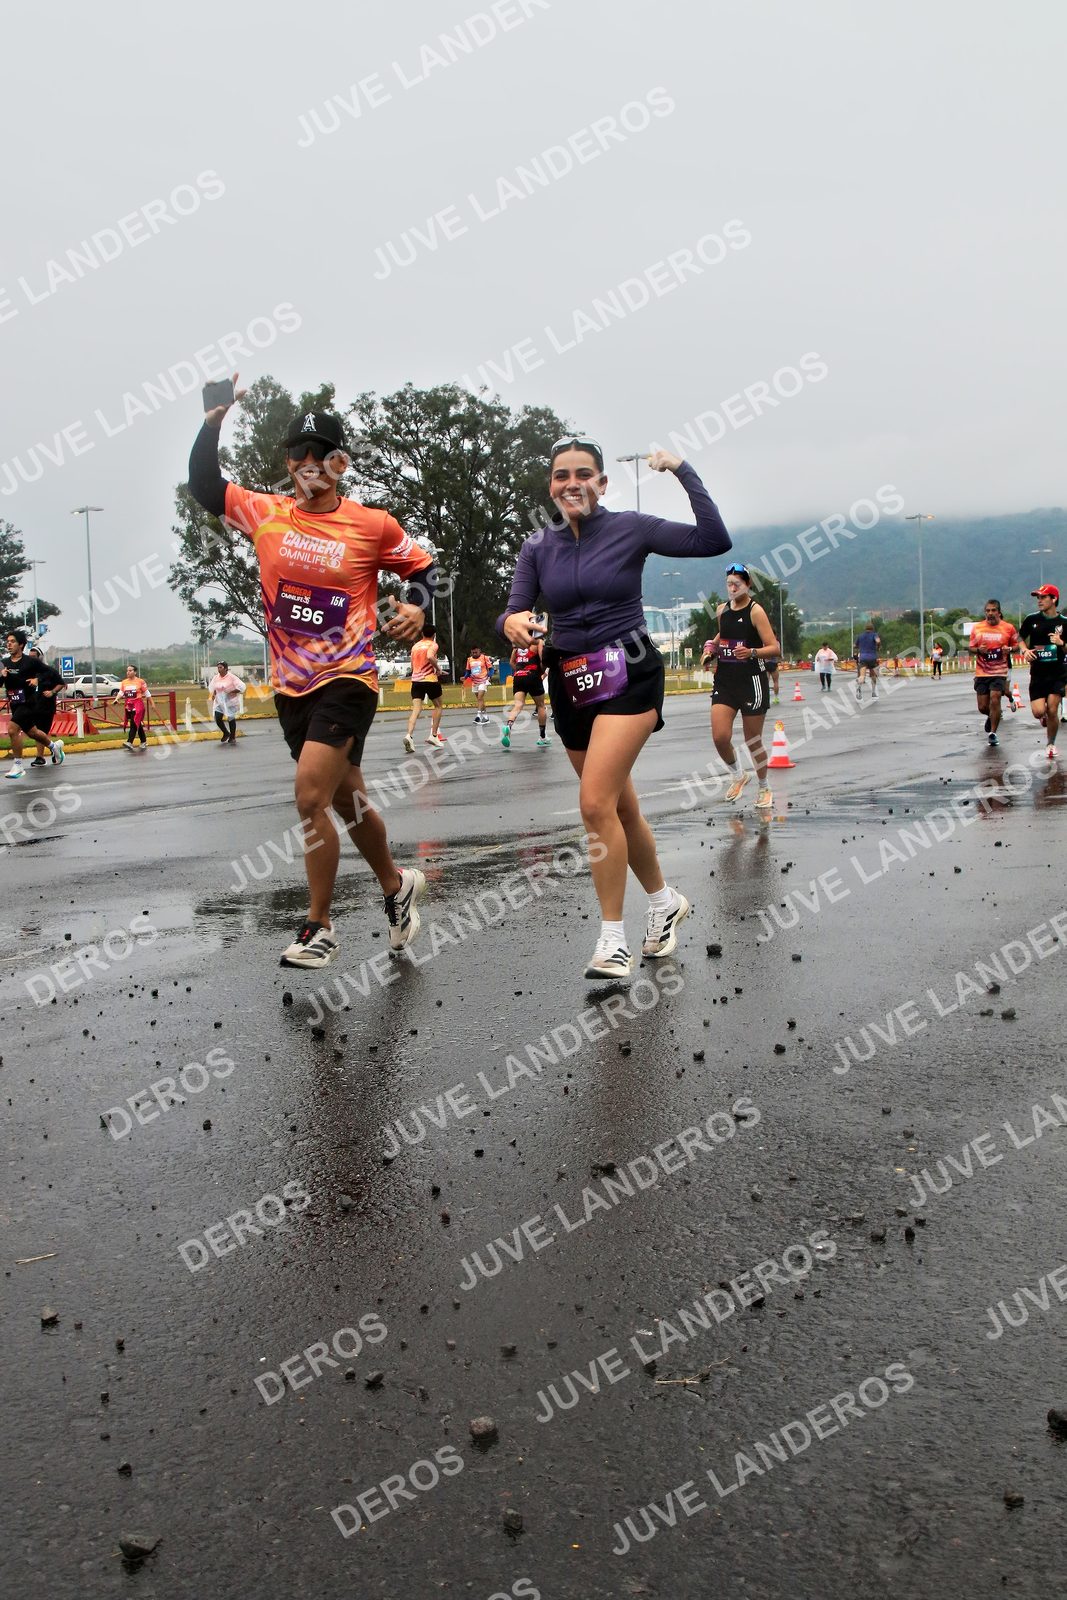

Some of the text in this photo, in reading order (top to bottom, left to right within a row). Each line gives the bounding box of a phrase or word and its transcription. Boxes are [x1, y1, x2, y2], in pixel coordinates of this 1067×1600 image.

[282, 530, 346, 557] CARRERA
[279, 546, 327, 566] OMNILIFE
[282, 584, 312, 597] CARRERA
[330, 595, 346, 607] 15K
[290, 604, 324, 625] 596
[576, 670, 603, 691] 597
